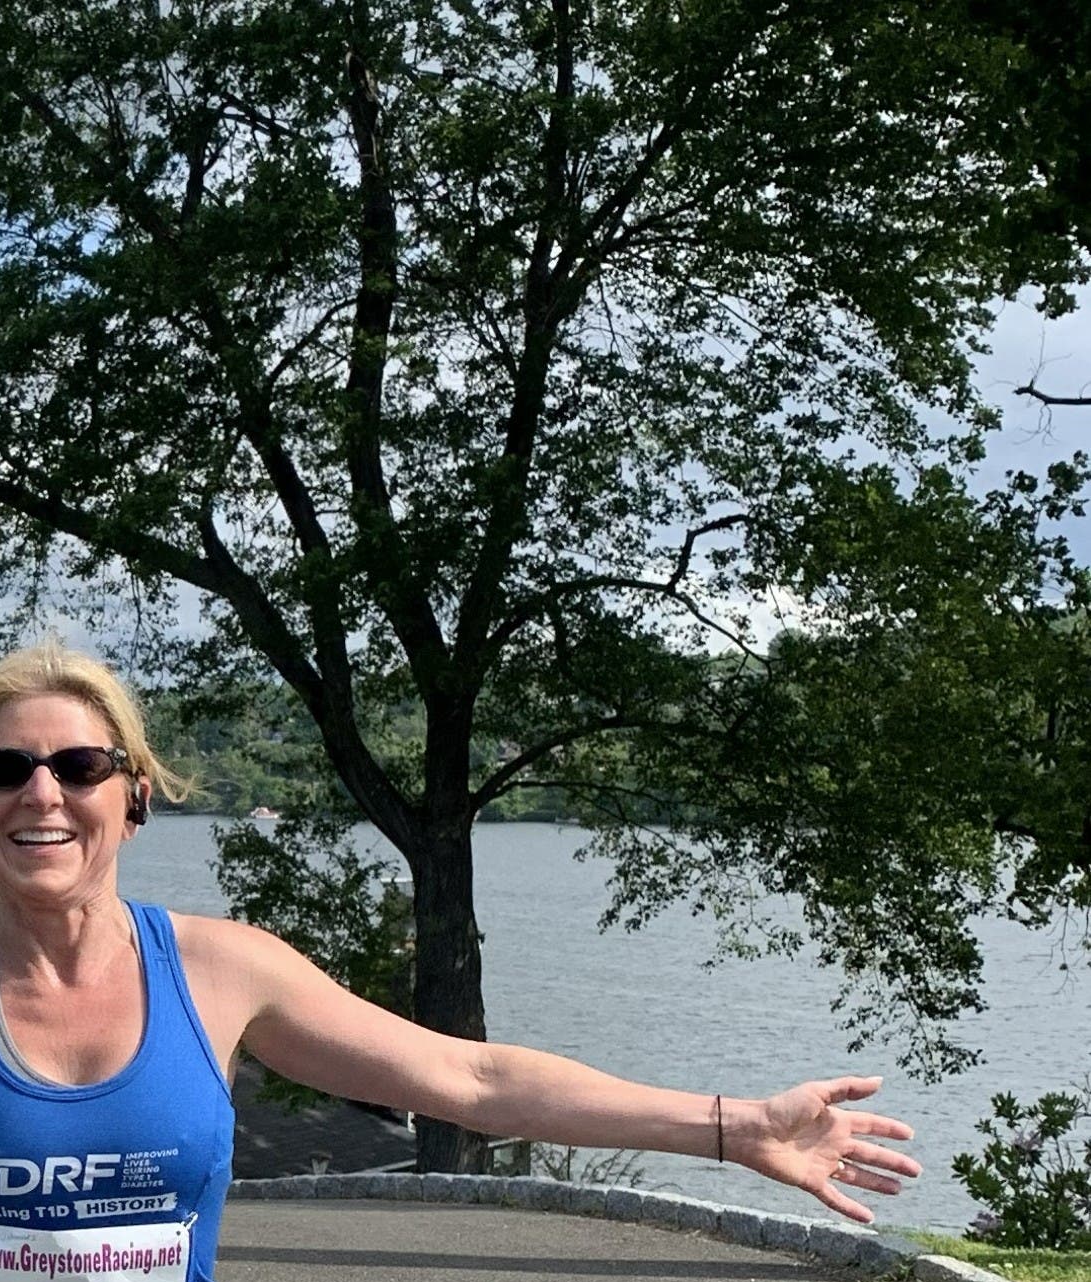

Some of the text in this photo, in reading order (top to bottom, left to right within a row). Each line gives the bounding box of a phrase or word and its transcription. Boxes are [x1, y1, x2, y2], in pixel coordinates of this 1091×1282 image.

[125, 1148, 179, 1159] IMPROVING
[123, 1165, 160, 1174] CURING
[35, 1205, 70, 1219] T1D
[86, 1197, 168, 1215] HISTORY
